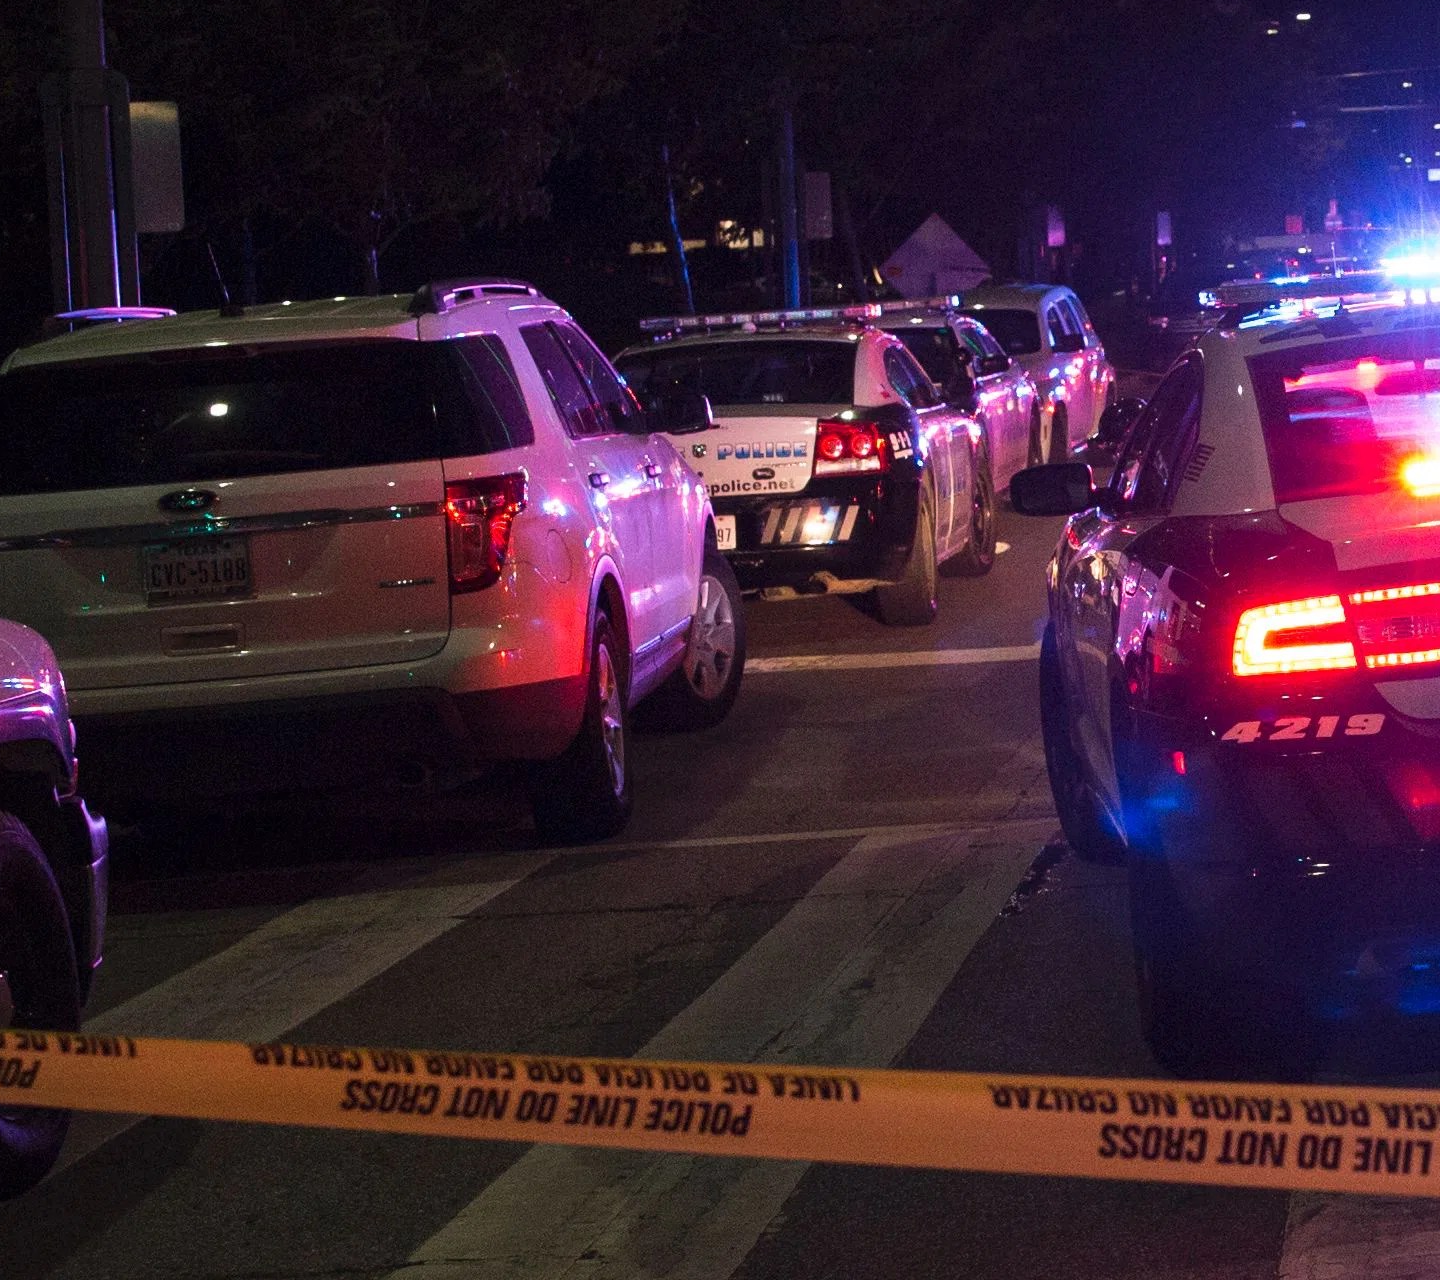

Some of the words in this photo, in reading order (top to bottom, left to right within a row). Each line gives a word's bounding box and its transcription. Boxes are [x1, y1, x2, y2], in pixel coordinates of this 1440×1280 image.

[717, 441, 808, 460] POLICE
[1221, 713, 1386, 744] 4219
[340, 1080, 440, 1114] CROSS
[444, 1086, 510, 1119] NOT
[516, 1090, 557, 1122] DO
[564, 1094, 637, 1129] LINE
[988, 1082, 1119, 1110] CRUZAR
[1127, 1090, 1178, 1117] NO
[1186, 1094, 1293, 1123] FAVOR
[1303, 1098, 1370, 1127] POR
[643, 1099, 752, 1135] POLICE
[1099, 1123, 1206, 1160] CROSS
[1218, 1128, 1288, 1167] NOT
[1297, 1133, 1344, 1170] DO
[1352, 1136, 1432, 1175] LINE
